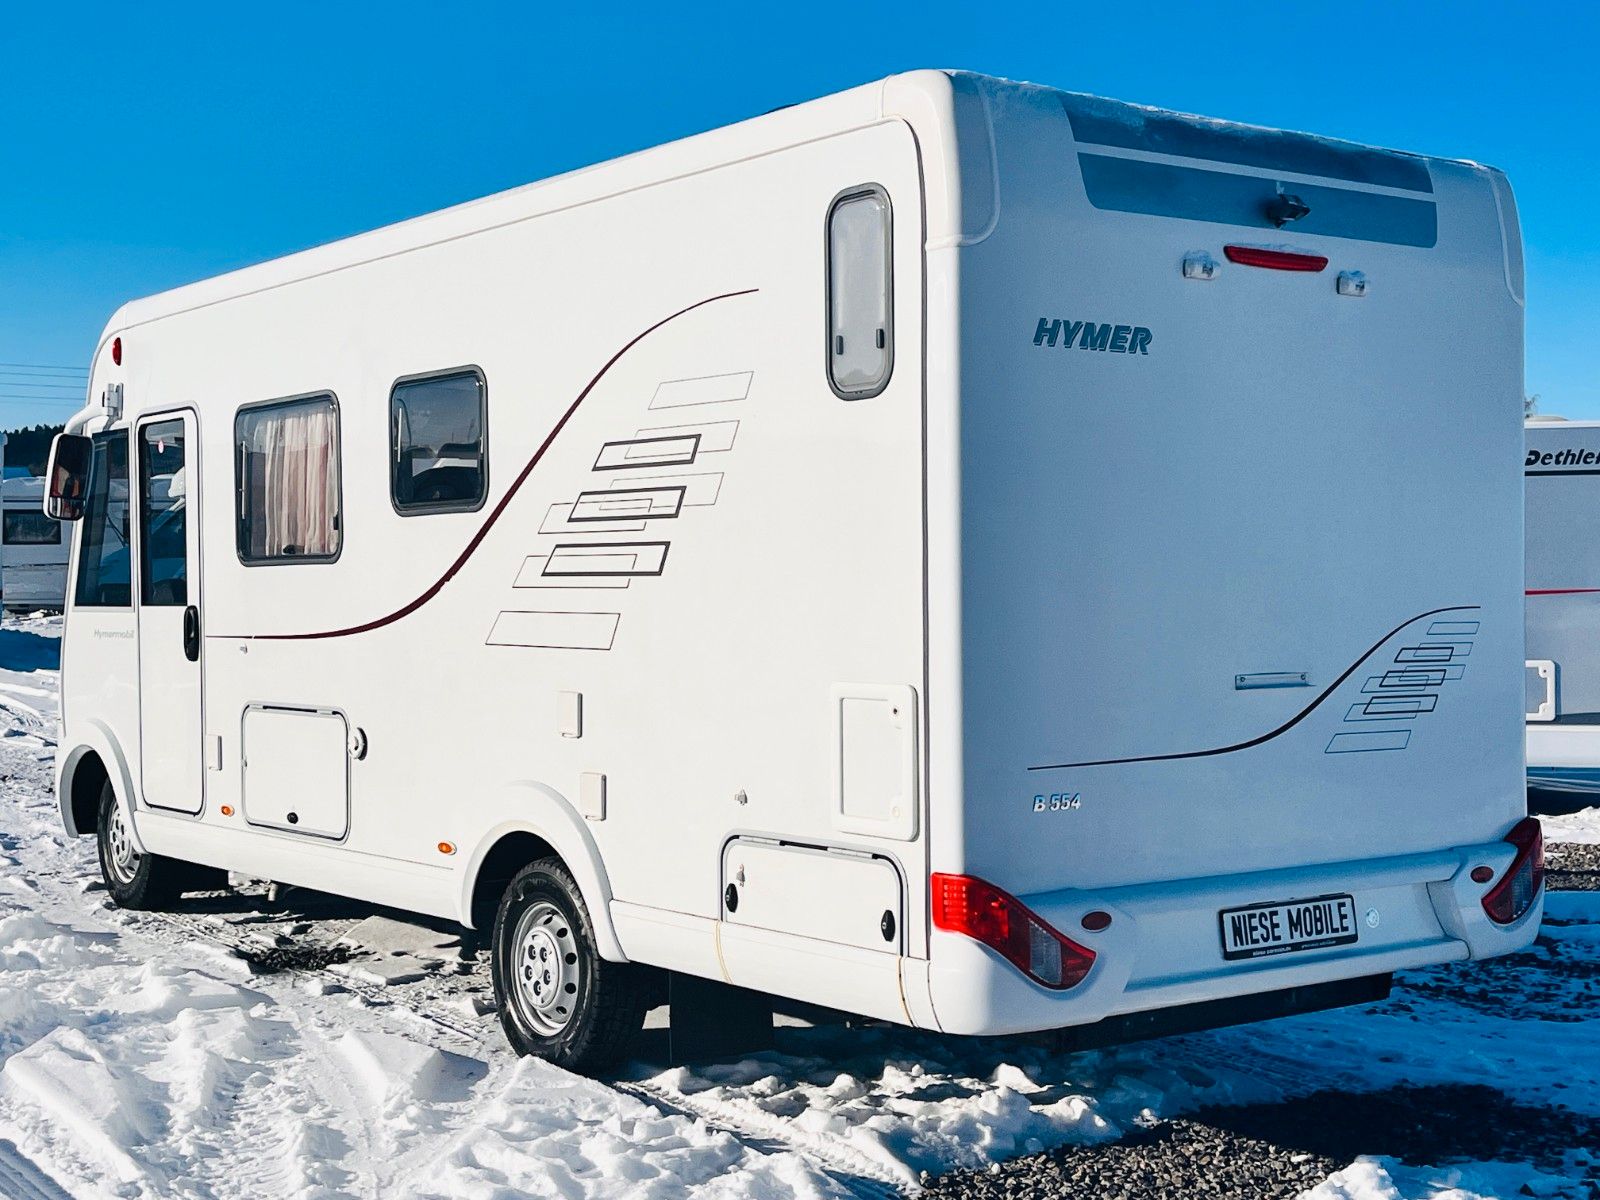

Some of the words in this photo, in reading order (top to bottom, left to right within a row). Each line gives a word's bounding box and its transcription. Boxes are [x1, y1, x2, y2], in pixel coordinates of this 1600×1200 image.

[1032, 317, 1153, 355] HYMER
[1033, 794, 1046, 812] B
[1049, 792, 1081, 811] 554
[1231, 910, 1282, 947] NIESE
[1287, 901, 1349, 940] MOBILE
